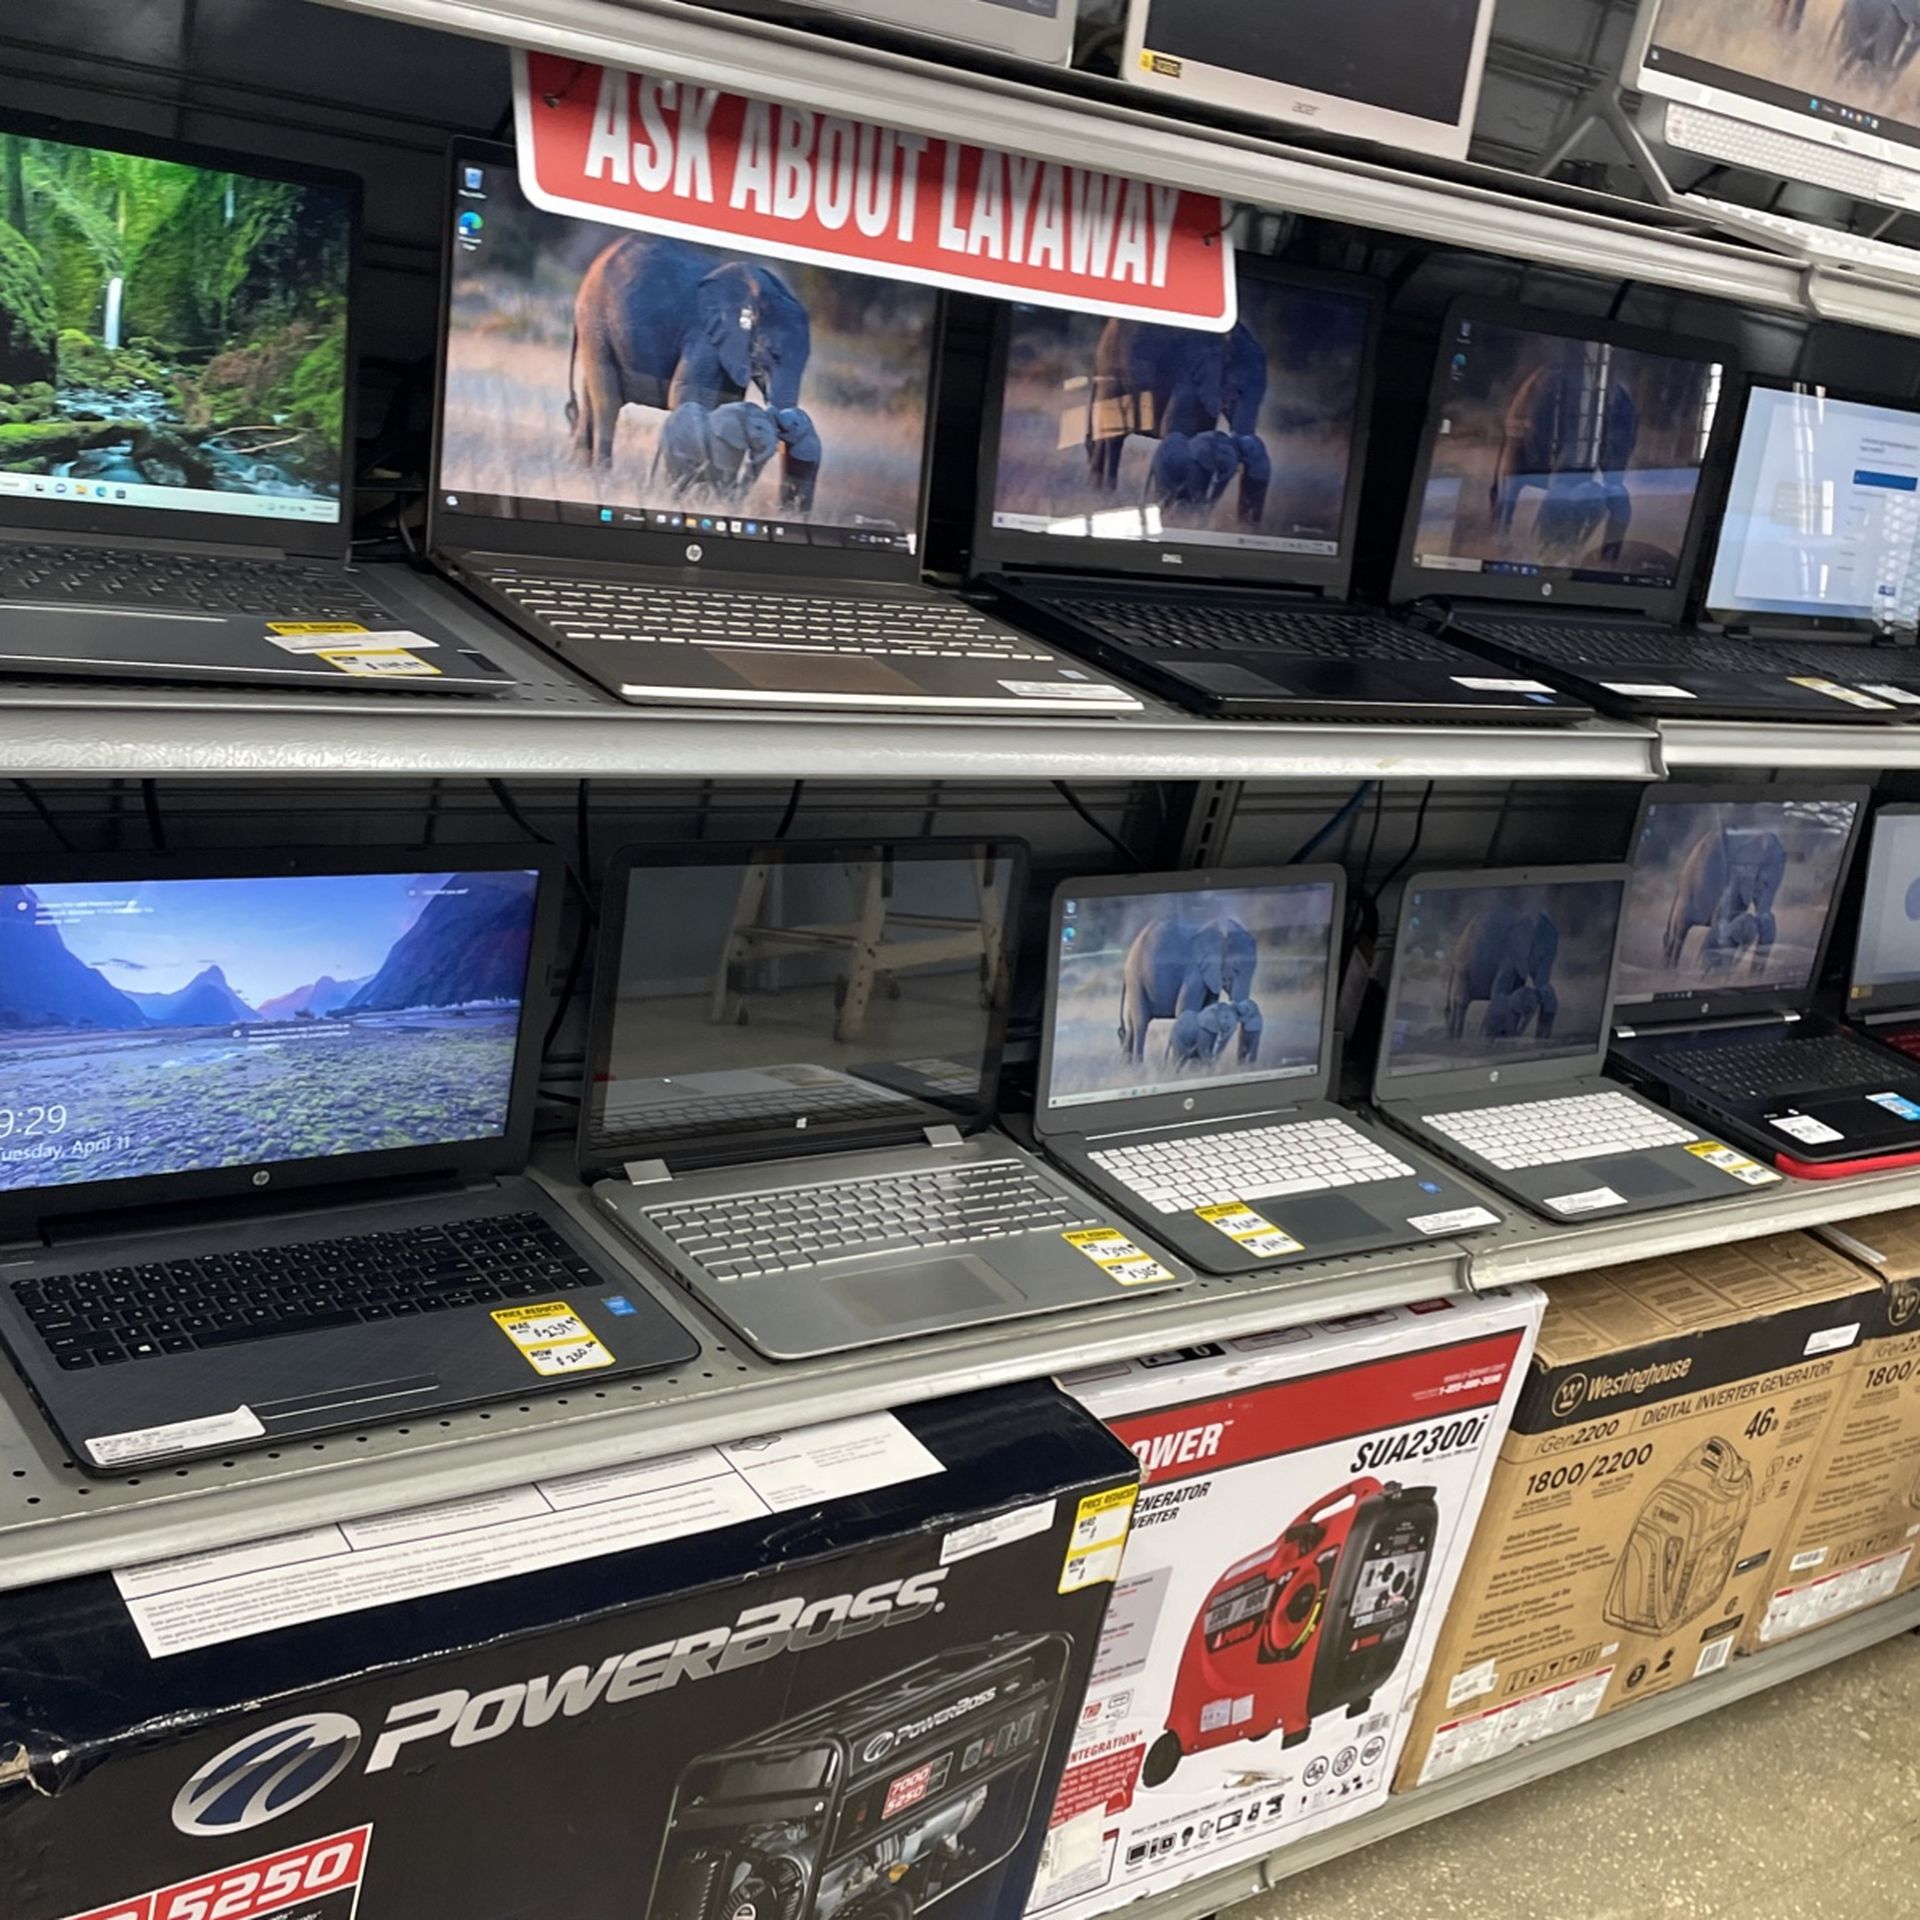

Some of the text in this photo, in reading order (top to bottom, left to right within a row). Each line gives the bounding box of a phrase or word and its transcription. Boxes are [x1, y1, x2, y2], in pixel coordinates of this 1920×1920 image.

[584, 64, 1181, 289] ASK ABOUT LAYAWAY
[0, 1135, 131, 1162] uesday, April 11
[496, 1303, 566, 1320] PRICE REDUCED
[508, 1321, 531, 1332] WAS
[530, 1349, 553, 1359] NOW
[1587, 1357, 1692, 1401] Westinghouse
[1641, 1359, 1835, 1428] DIGITAL INVERTER GENERATOR
[1350, 1413, 1490, 1474] SUA2300i
[1535, 1419, 1620, 1456] iGen2200
[1526, 1443, 1654, 1497] 1800/2200
[364, 1567, 949, 1774] POWERBOSS
[893, 1687, 997, 1746] POWERBOSS
[167, 1842, 354, 1920] 5250
